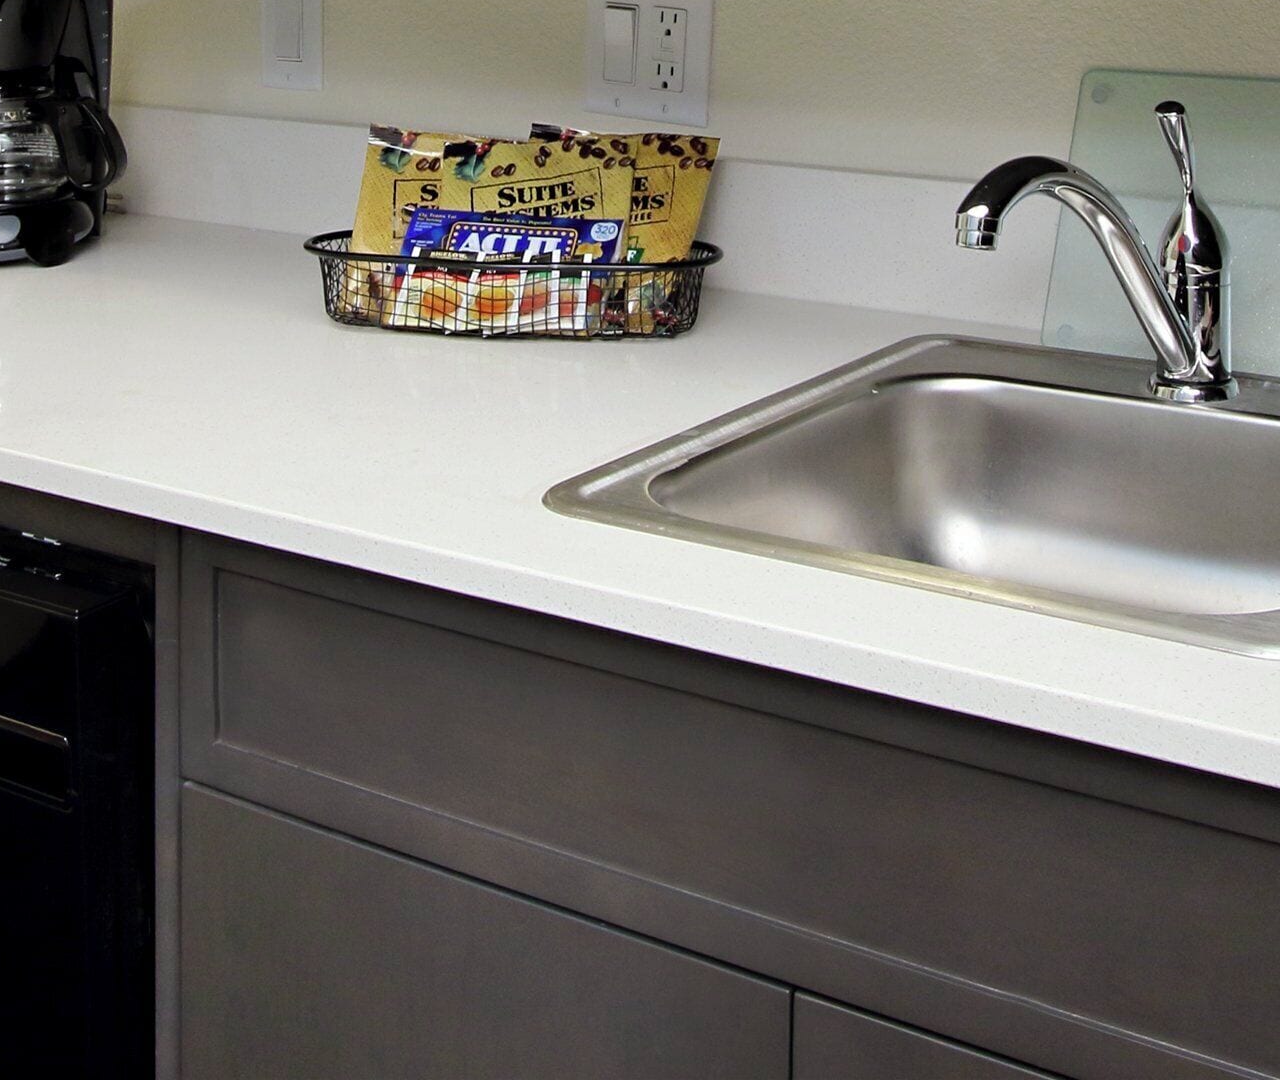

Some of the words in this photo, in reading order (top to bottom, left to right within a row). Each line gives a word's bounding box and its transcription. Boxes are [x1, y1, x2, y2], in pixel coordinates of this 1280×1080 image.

[497, 181, 576, 209] SUITE
[594, 224, 616, 235] 320
[458, 231, 522, 255] ACT
